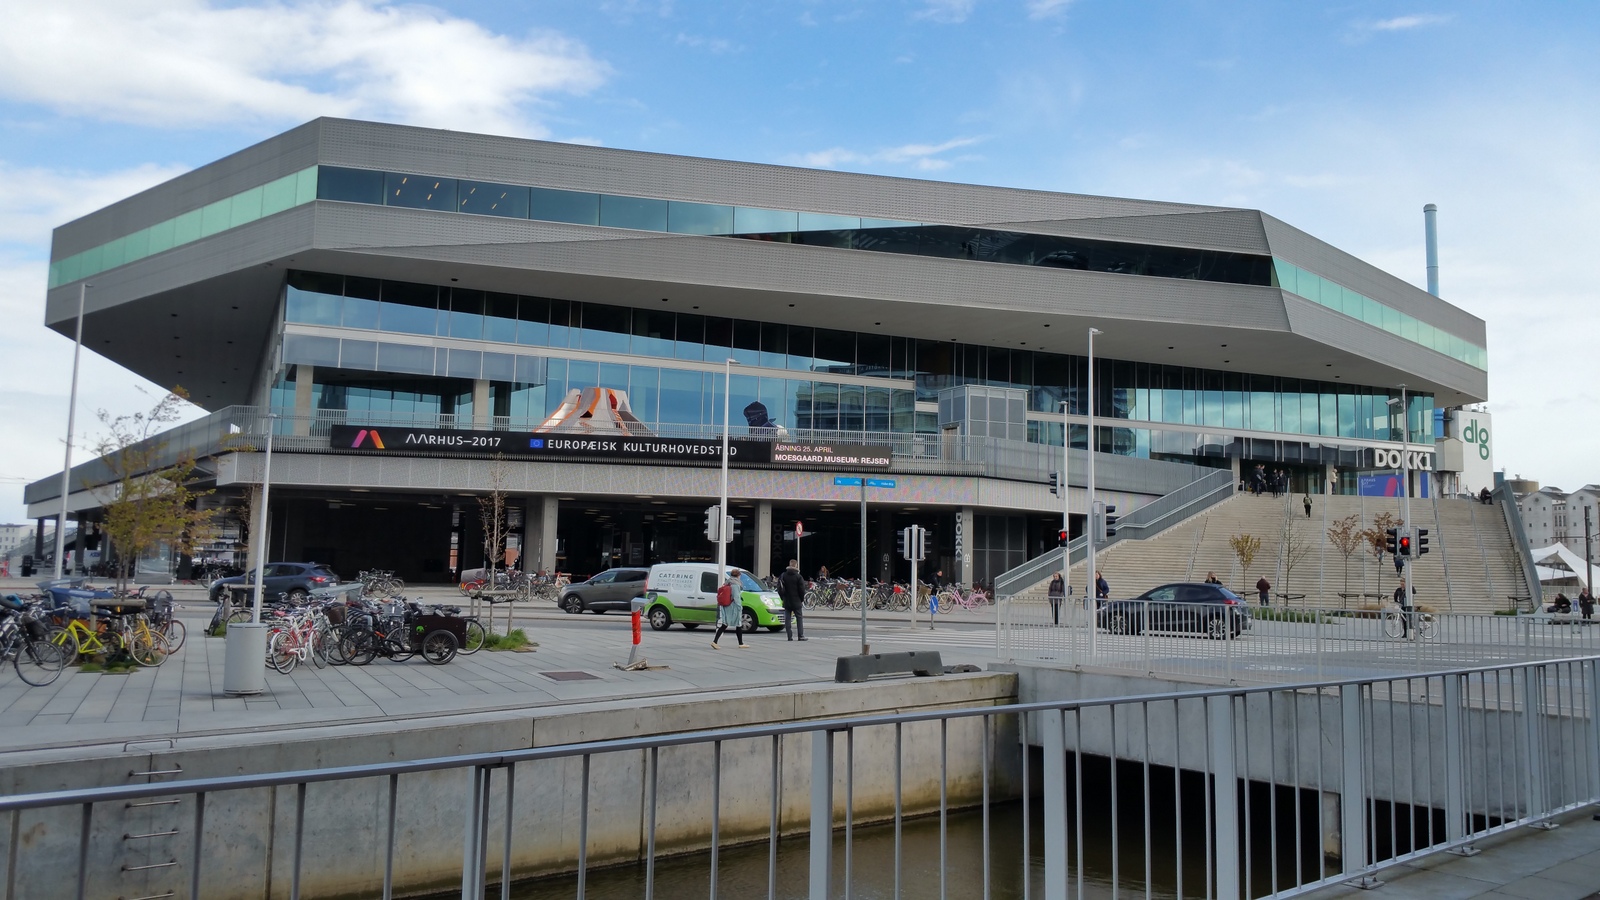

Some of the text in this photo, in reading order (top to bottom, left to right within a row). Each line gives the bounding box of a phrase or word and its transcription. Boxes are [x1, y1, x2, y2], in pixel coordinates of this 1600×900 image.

[547, 439, 738, 456] EUROPÆISK KULTURHOVEDSTD
[775, 444, 802, 452] ÅBNING
[1463, 419, 1490, 460] dlg
[775, 454, 890, 465] MOESGAARD MUSEUM: REJSEN
[1374, 448, 1433, 471] DOKK1
[955, 512, 963, 563] DOKK1
[658, 572, 694, 580] CATERING
